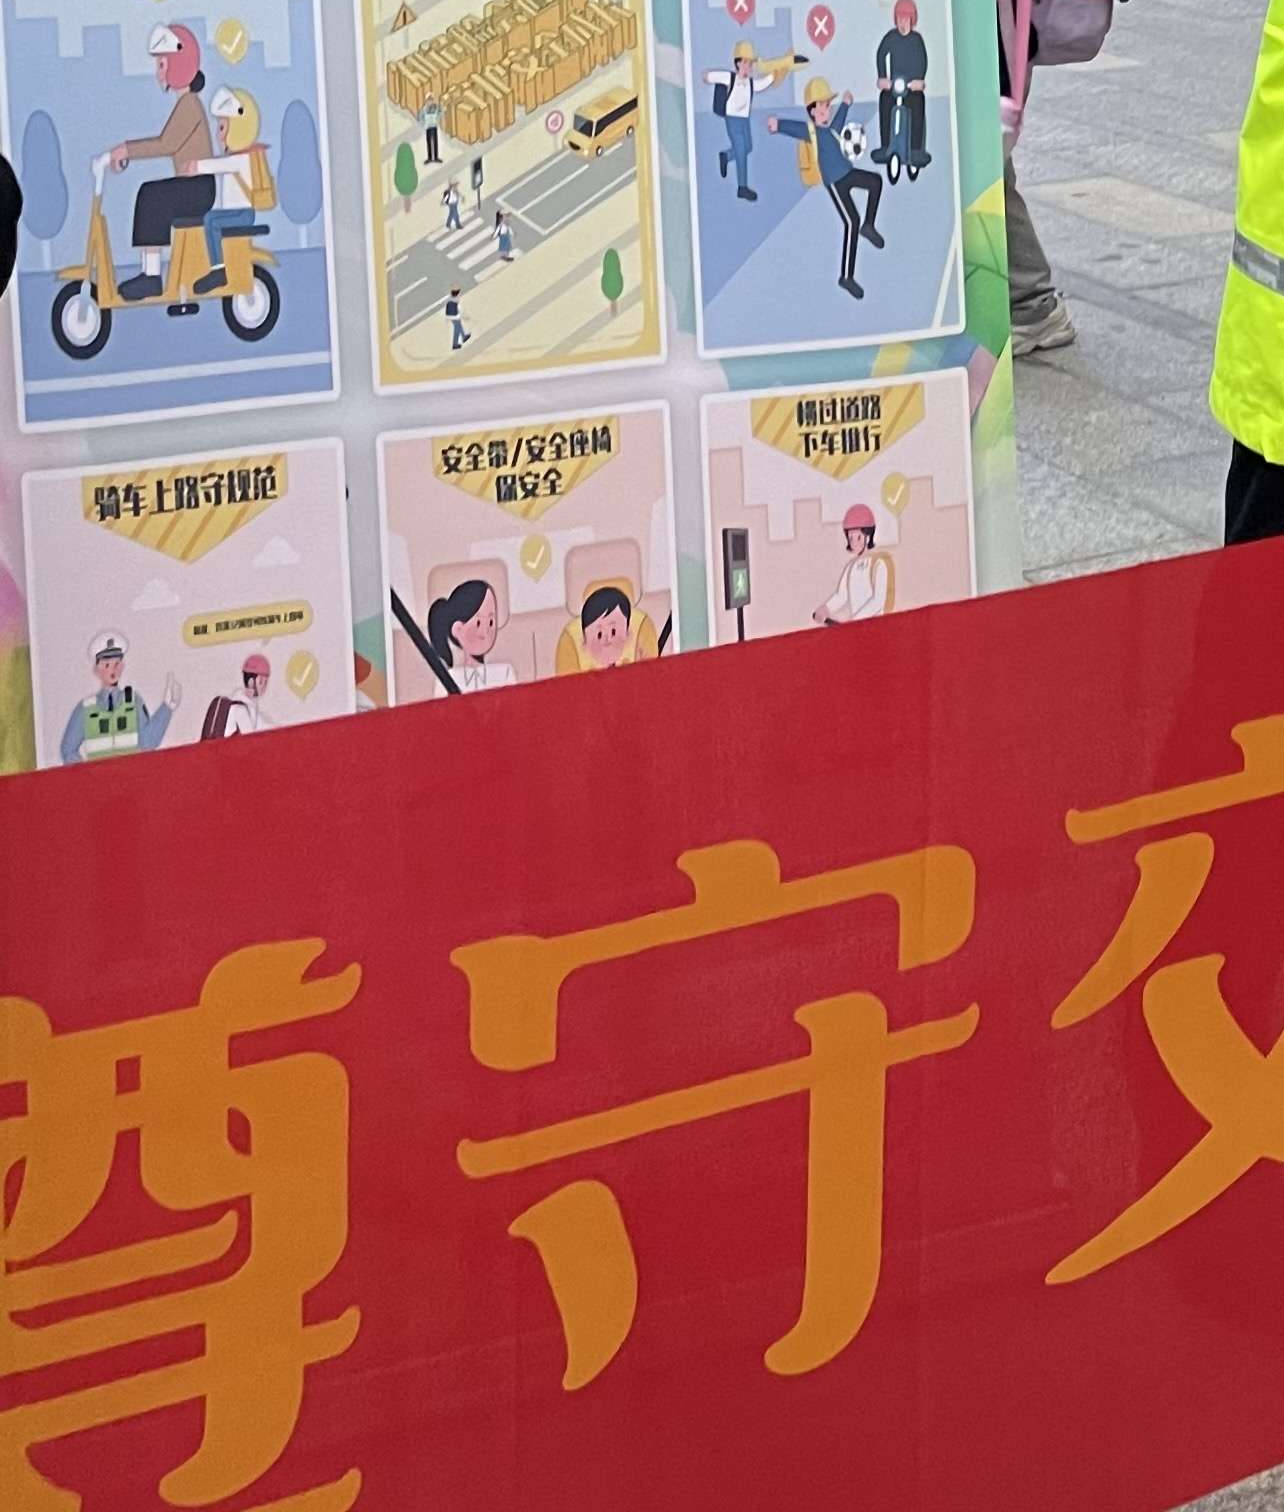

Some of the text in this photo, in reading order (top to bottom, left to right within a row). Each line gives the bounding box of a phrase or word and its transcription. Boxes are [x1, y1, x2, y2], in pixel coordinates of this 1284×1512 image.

[797, 394, 881, 427] 横过道路
[441, 426, 612, 475] 安全带/安全座椅
[798, 425, 882, 458] 下车推行
[94, 465, 279, 521] 骑车上路守规范
[495, 468, 566, 504] 保安全
